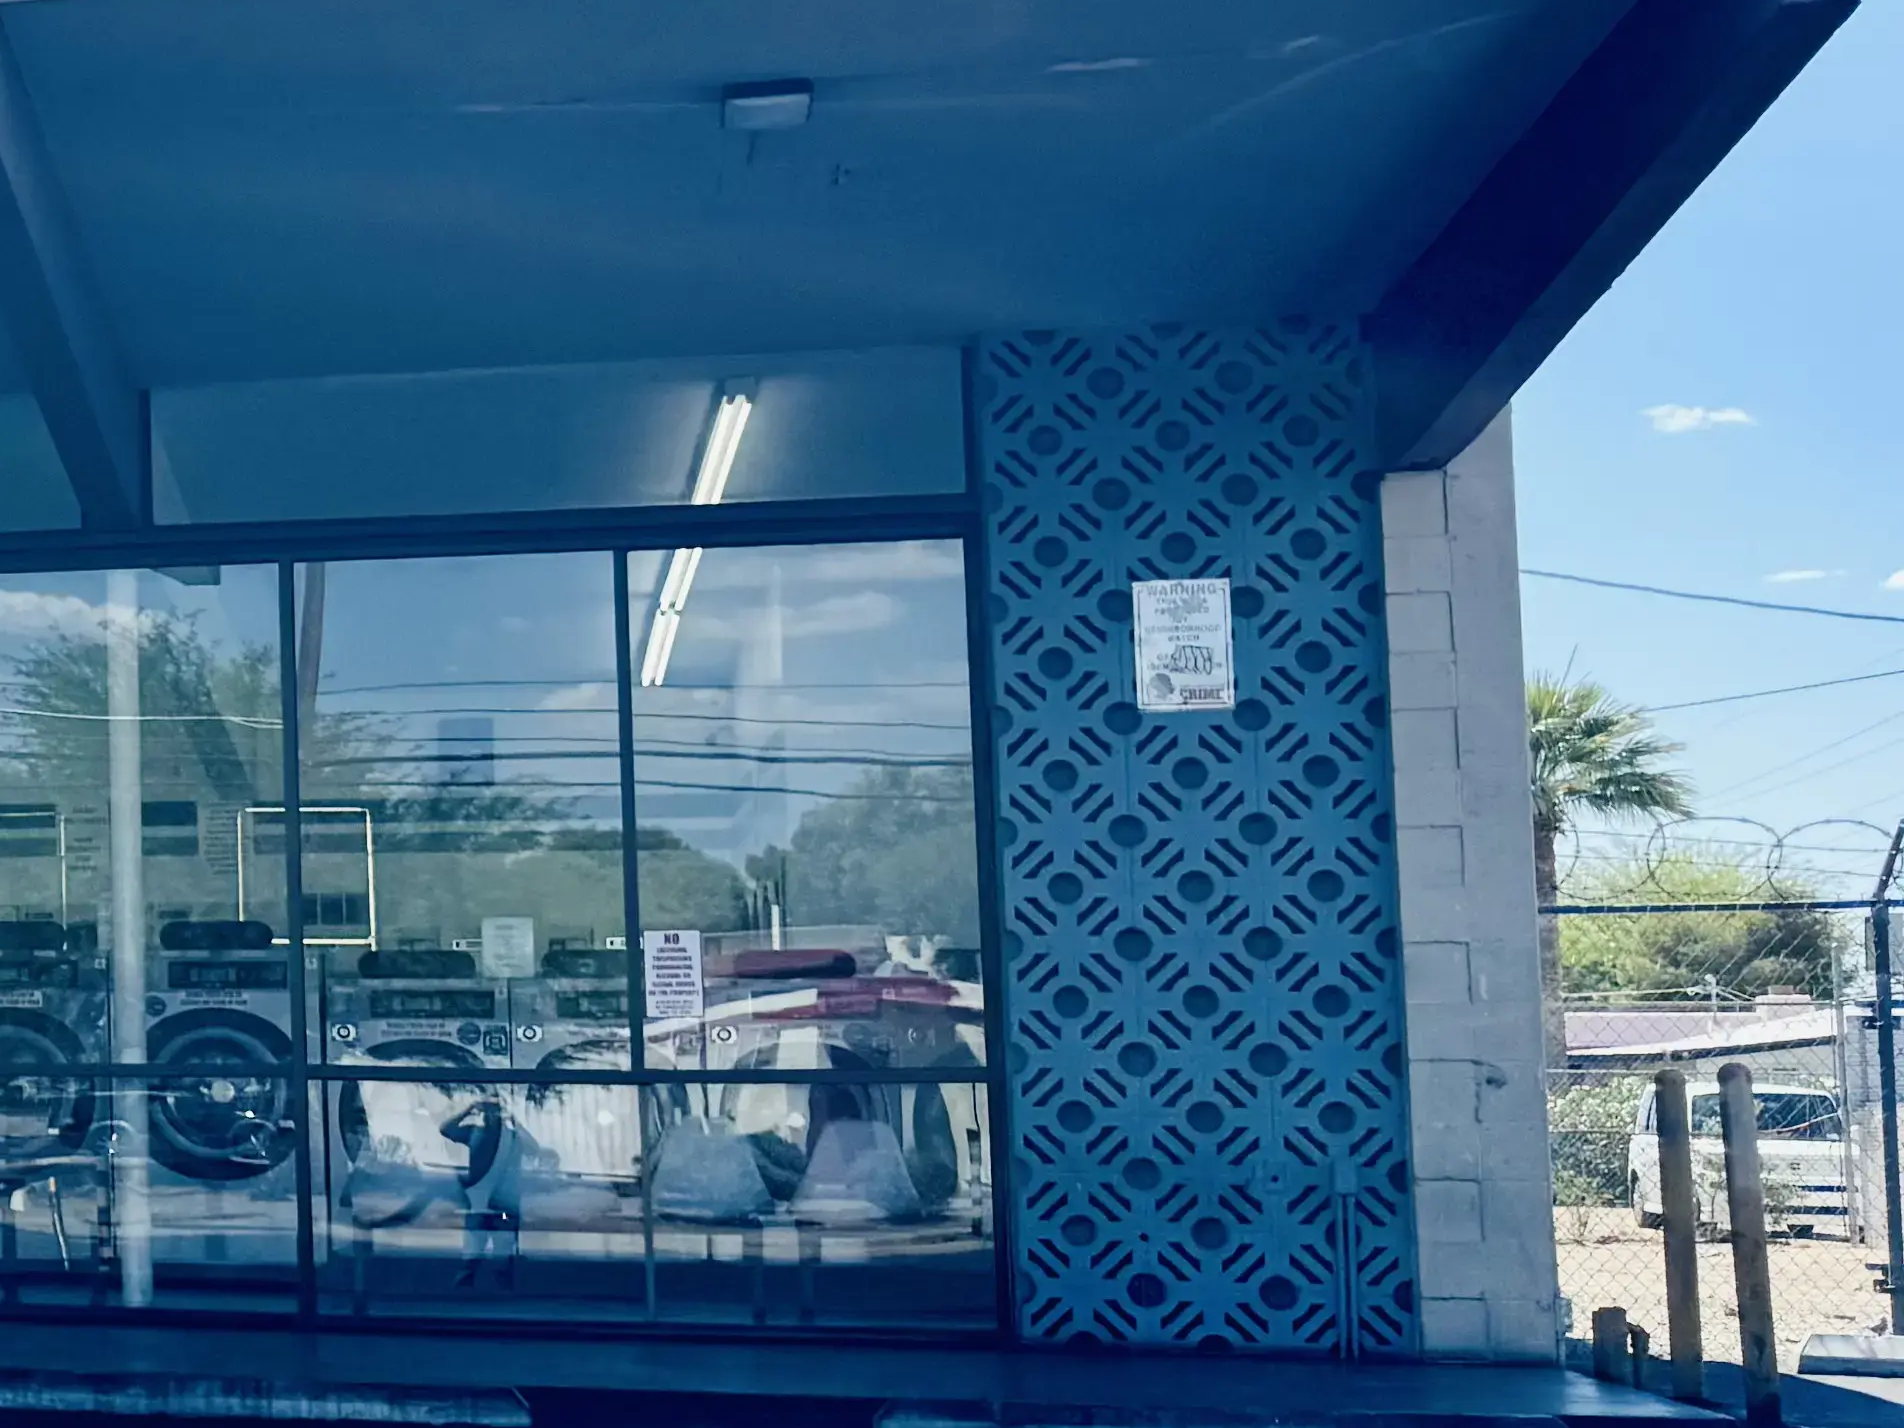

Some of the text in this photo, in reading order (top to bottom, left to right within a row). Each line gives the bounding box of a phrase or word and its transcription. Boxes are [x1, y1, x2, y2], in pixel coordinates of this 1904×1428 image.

[1146, 583, 1217, 596] WARNING
[1180, 688, 1223, 701] CRIME
[664, 933, 680, 944] NO
